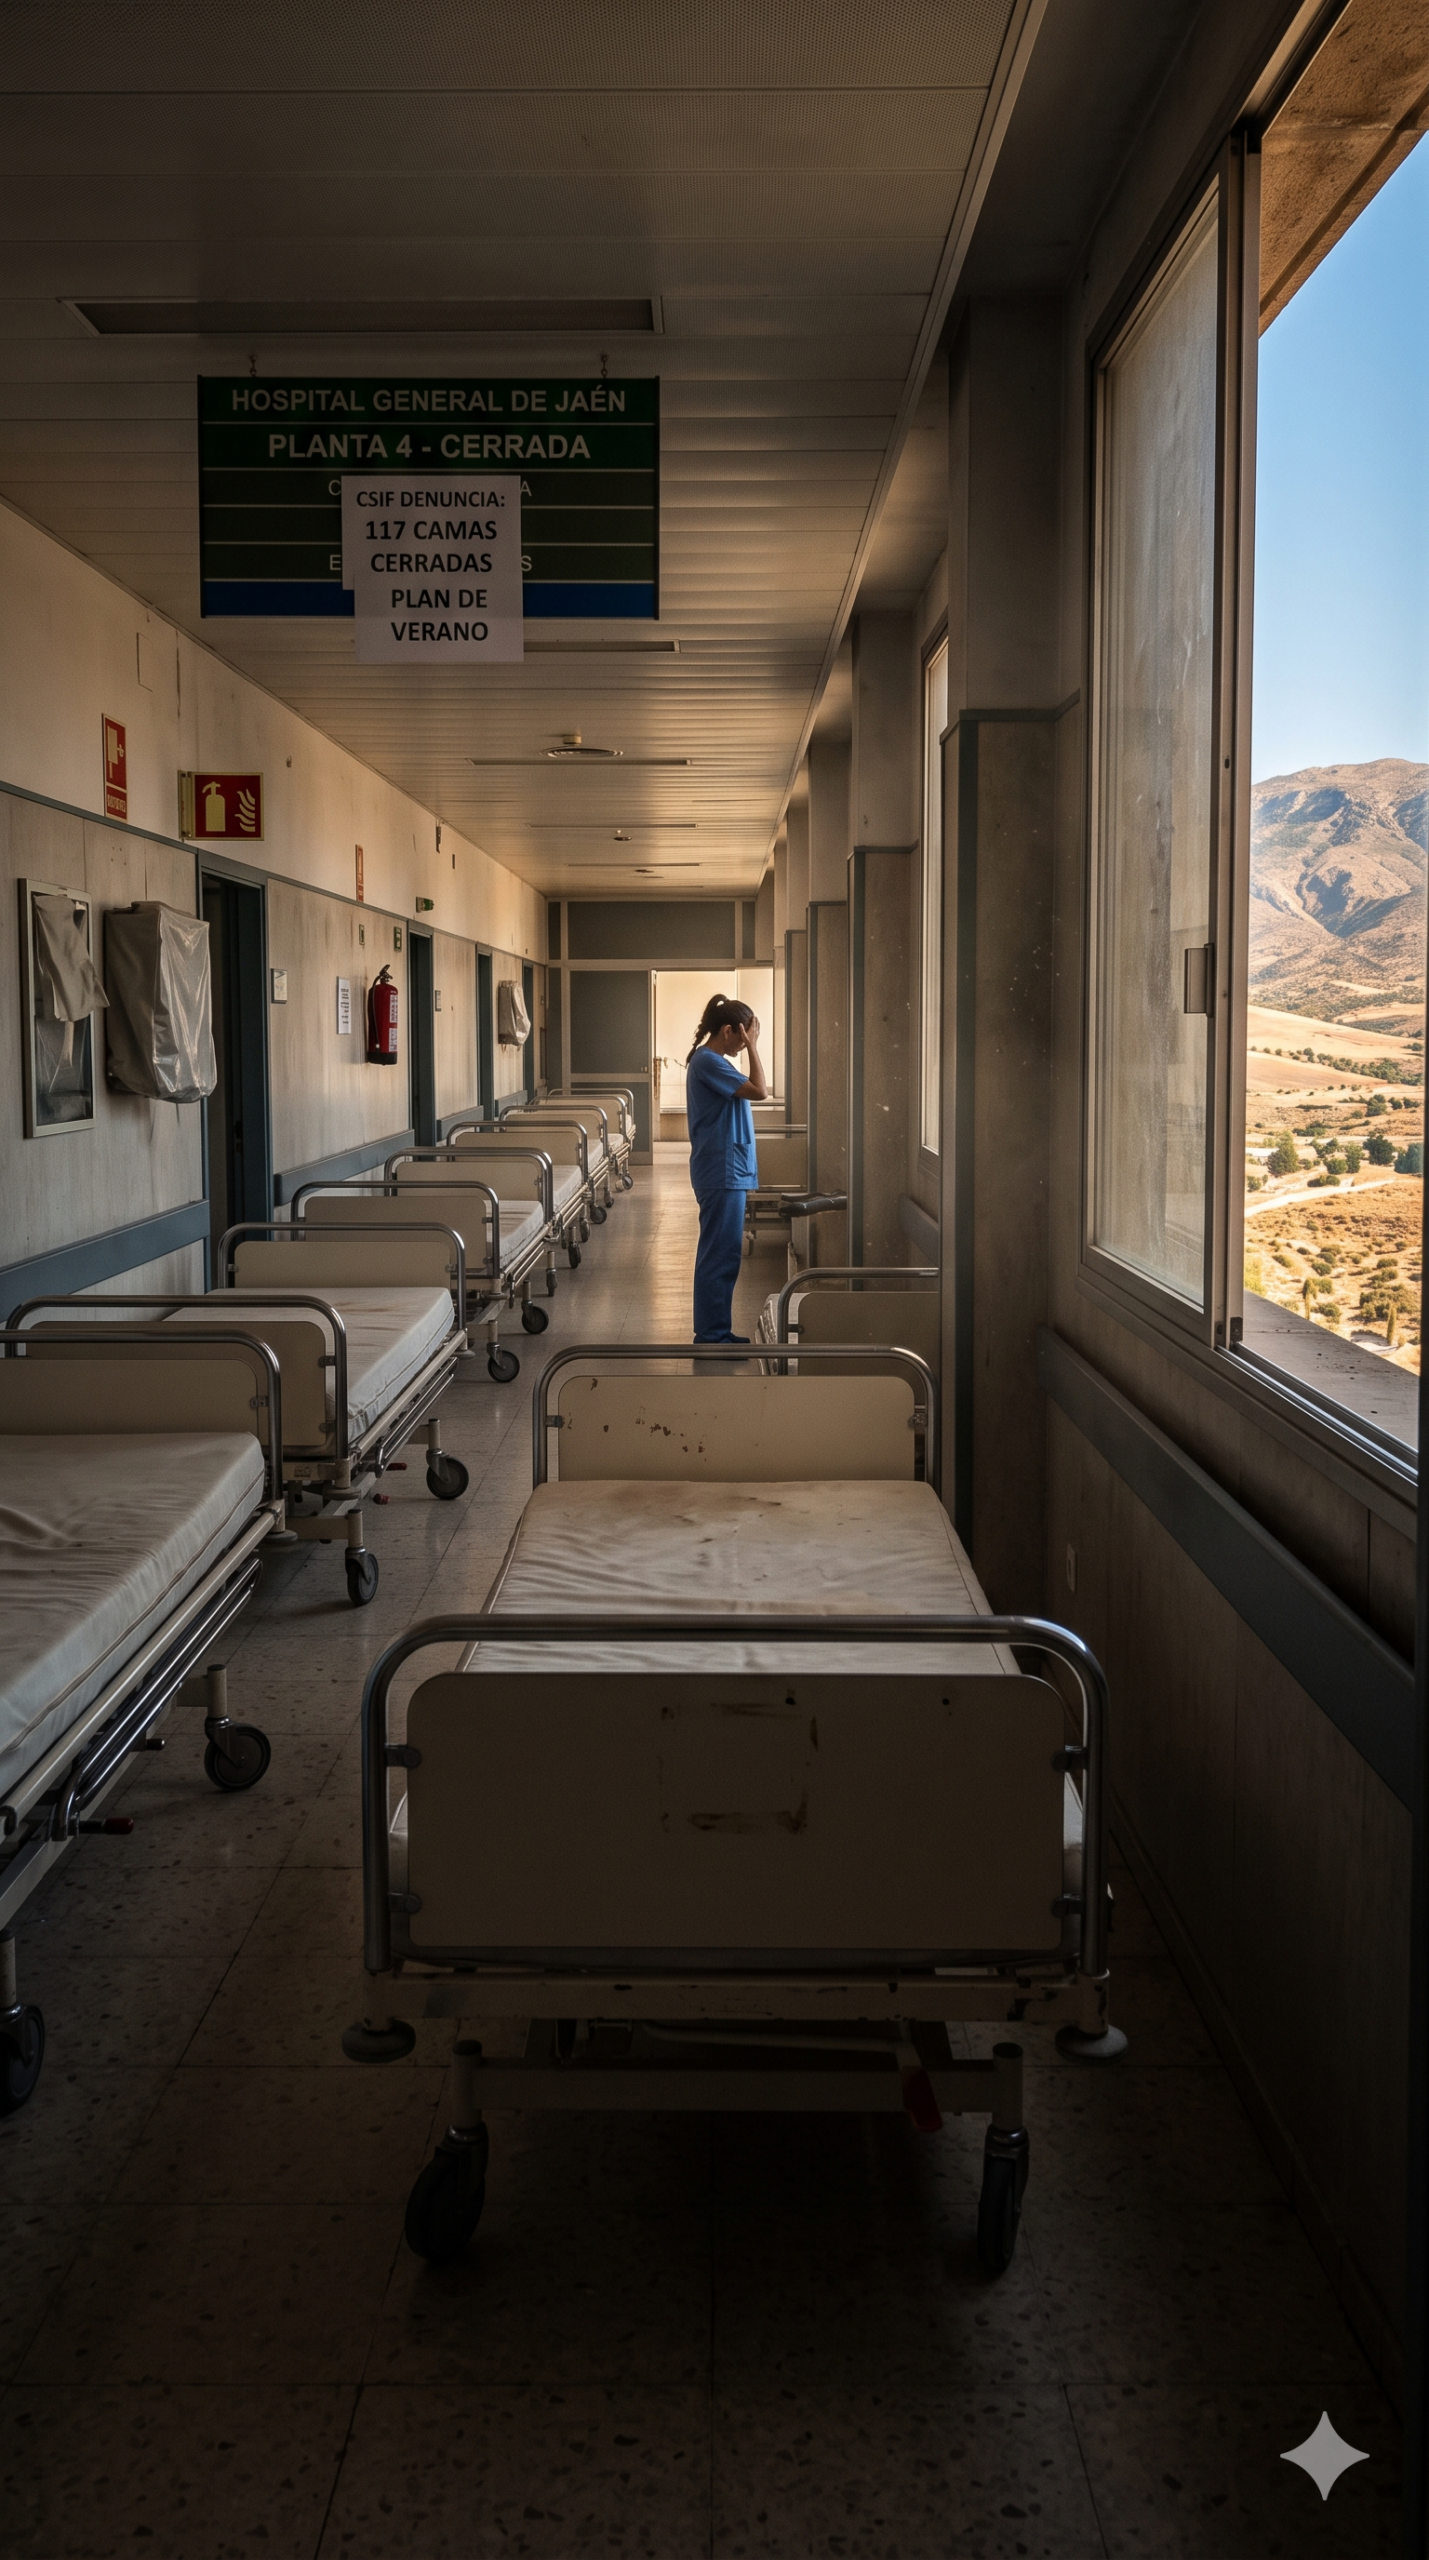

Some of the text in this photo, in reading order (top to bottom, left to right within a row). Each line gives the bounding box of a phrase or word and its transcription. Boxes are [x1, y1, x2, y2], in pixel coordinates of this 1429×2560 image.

[232, 384, 625, 412] HOSPITAL GENERAL DE JAÉN
[269, 434, 389, 458] PLANTA
[395, 434, 413, 458] 4
[440, 434, 591, 459] CERRADA
[356, 491, 505, 508] CSIF DENUNCIA:
[366, 520, 498, 540] 117 CAMAS
[370, 553, 493, 573] CERRADAS
[391, 589, 488, 609] PLAN DE
[390, 621, 489, 642] VERANO
